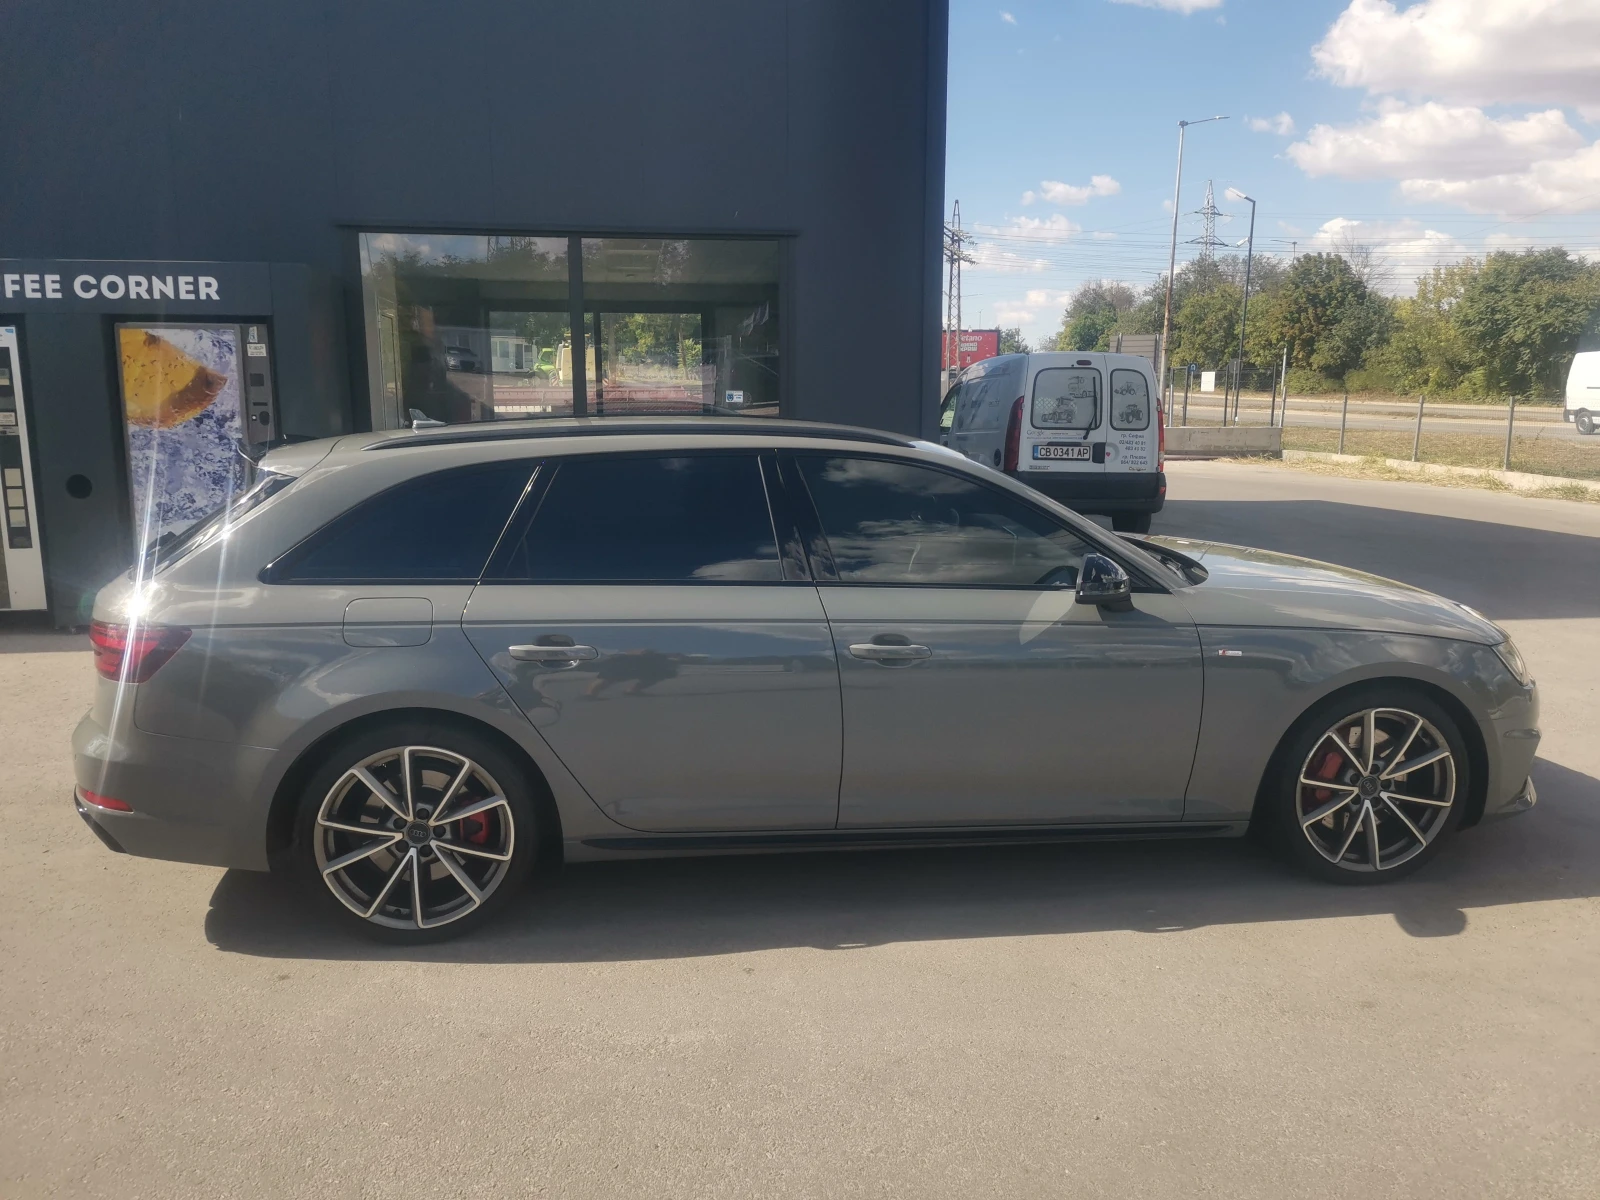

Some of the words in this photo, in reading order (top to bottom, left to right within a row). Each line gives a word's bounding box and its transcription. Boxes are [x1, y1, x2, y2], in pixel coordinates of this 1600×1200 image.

[3, 273, 63, 299] FEE
[73, 274, 220, 300] CORNER
[1039, 447, 1051, 457] CB
[1053, 447, 1074, 457] 0341
[1076, 448, 1088, 457] AP
